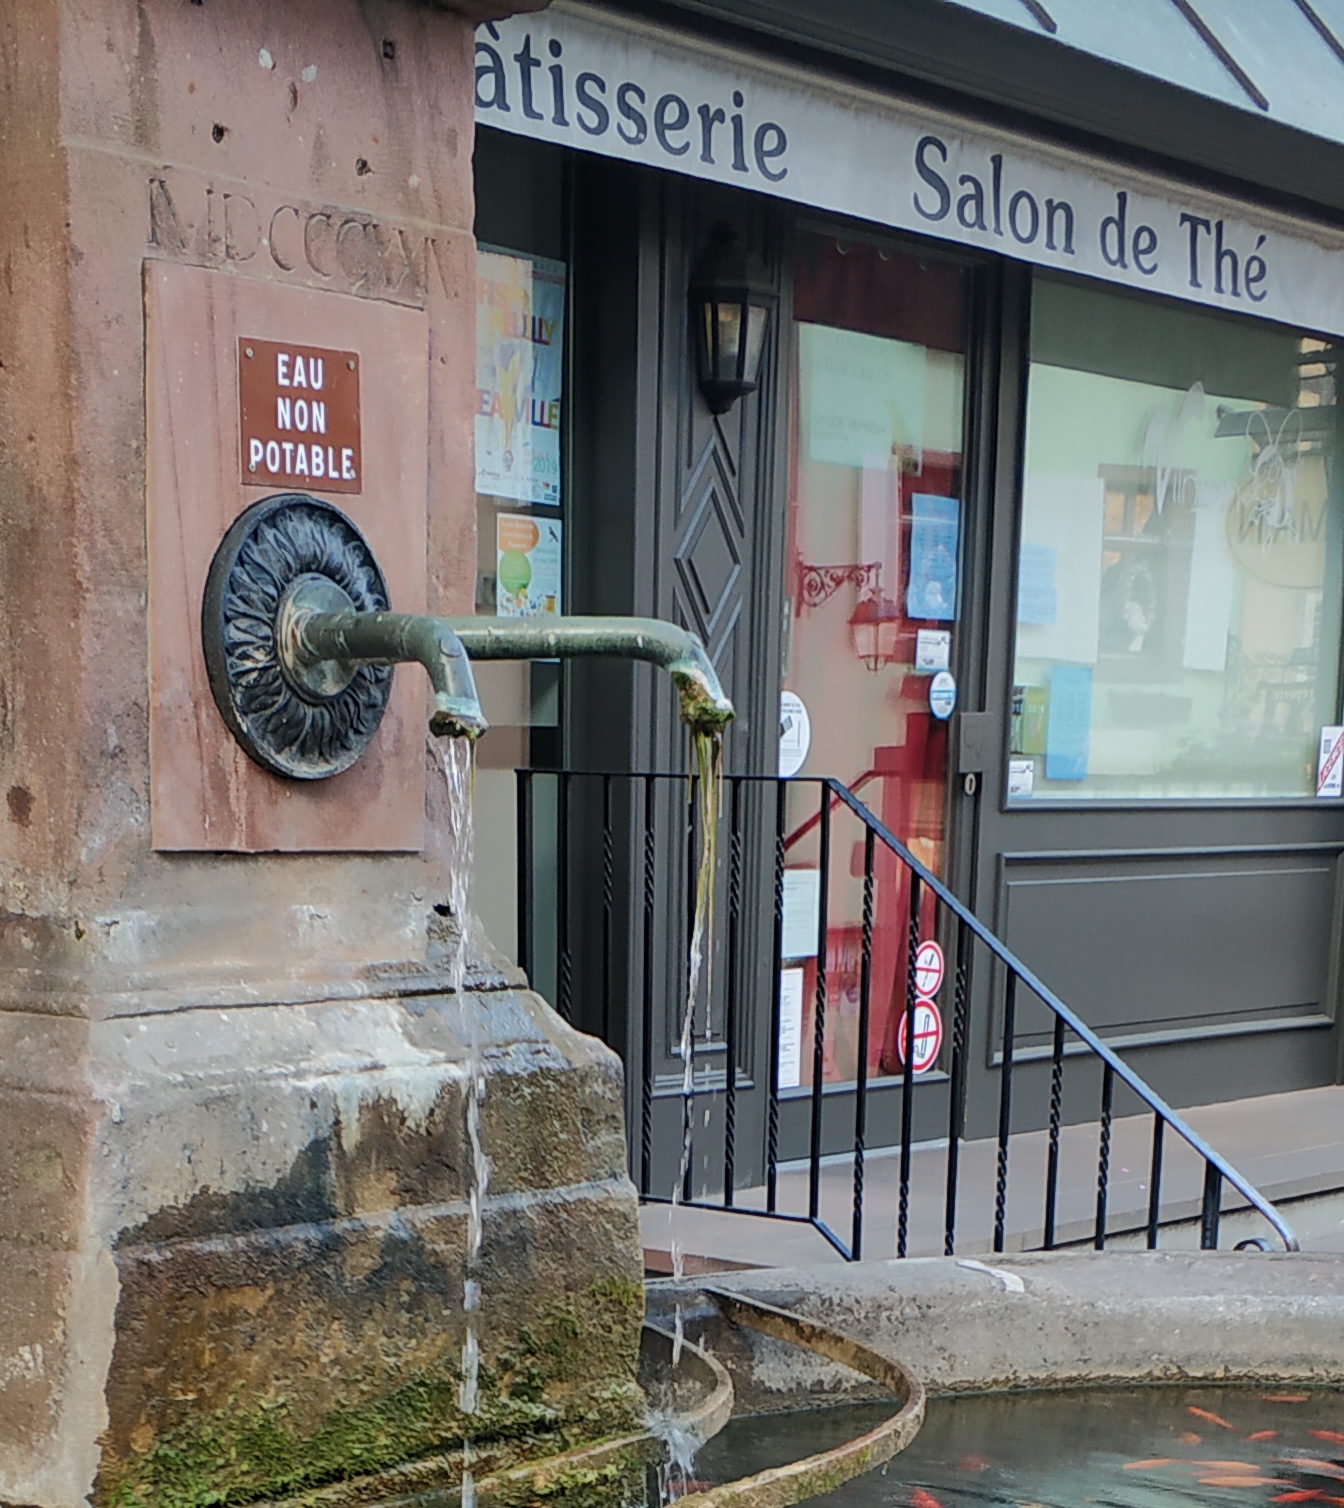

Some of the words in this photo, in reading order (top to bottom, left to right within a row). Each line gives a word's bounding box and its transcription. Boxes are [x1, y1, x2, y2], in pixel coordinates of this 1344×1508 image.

[912, 134, 1076, 256] Salon
[1099, 190, 1159, 276] de
[1179, 212, 1270, 303] Thé
[276, 352, 324, 391] EAU
[276, 396, 327, 435] NON
[248, 437, 355, 480] POTABLE
[533, 456, 558, 475] 2019
